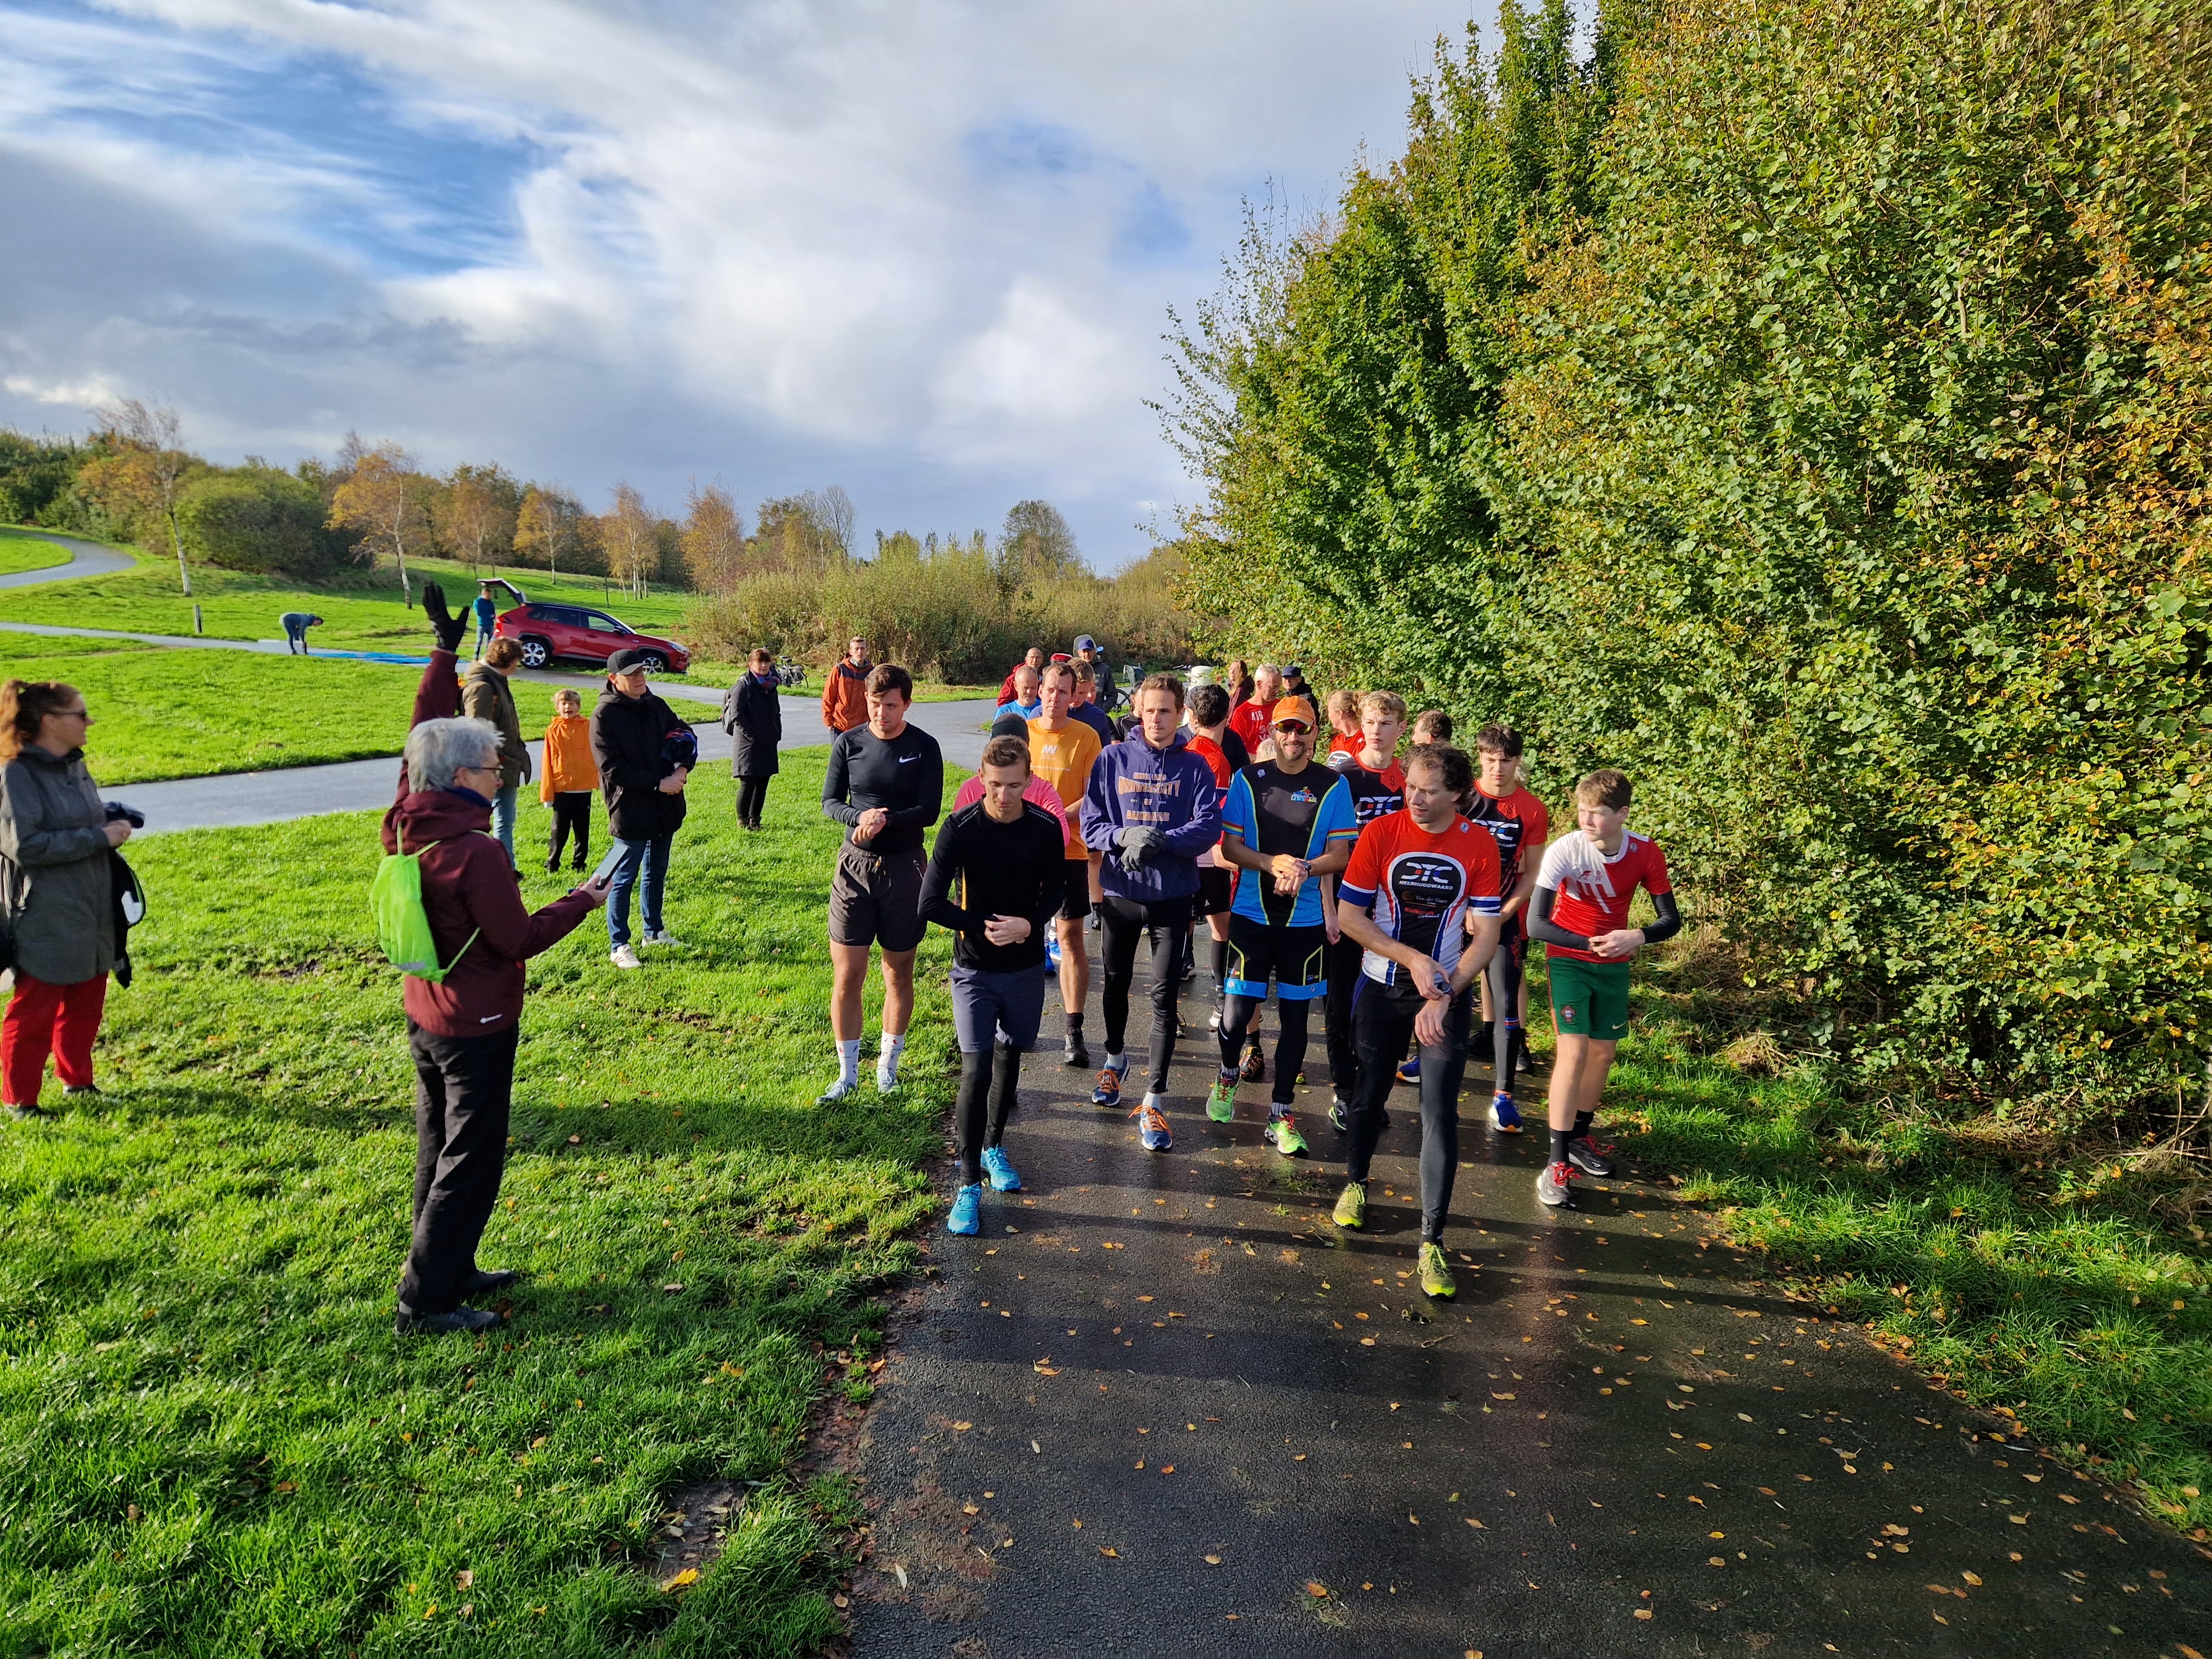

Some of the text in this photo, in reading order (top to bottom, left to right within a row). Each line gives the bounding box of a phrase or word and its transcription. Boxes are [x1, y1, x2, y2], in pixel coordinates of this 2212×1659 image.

[1251, 710, 1264, 722] 416
[1118, 776, 1181, 797] UNIVERSITY
[1126, 810, 1170, 821] ALKMAAR
[1401, 862, 1453, 884] DTC
[1399, 880, 1453, 890] HEERHUGOWAARD
